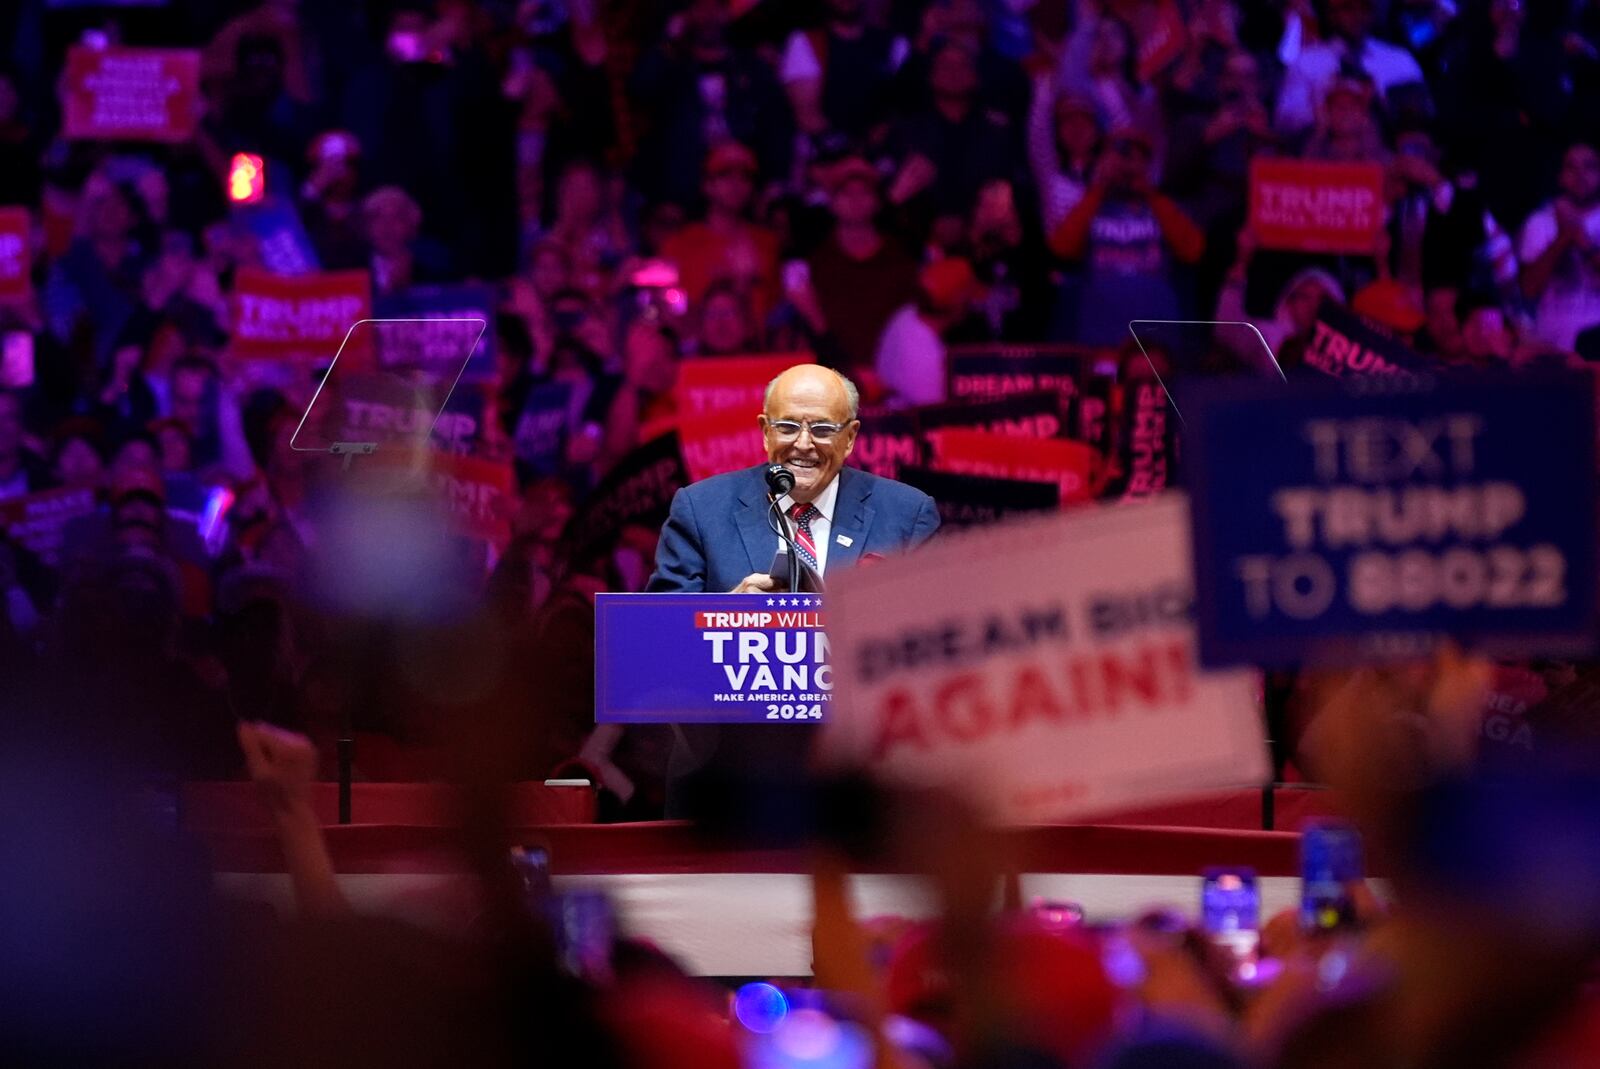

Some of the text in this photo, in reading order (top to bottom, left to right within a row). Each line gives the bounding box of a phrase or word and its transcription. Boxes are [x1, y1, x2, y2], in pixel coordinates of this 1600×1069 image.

[1259, 183, 1374, 212] TRUMP
[1303, 413, 1486, 481] TEXT
[1269, 479, 1527, 551] TRUMP
[1234, 549, 1337, 622] TO
[703, 612, 824, 628] TRUMP WILL
[859, 602, 1064, 684] DREAM
[714, 693, 833, 702] MAKE AMERICA GREAT
[723, 664, 834, 691] VANC
[869, 637, 1190, 763] AGAIN!
[766, 704, 823, 720] 2024
